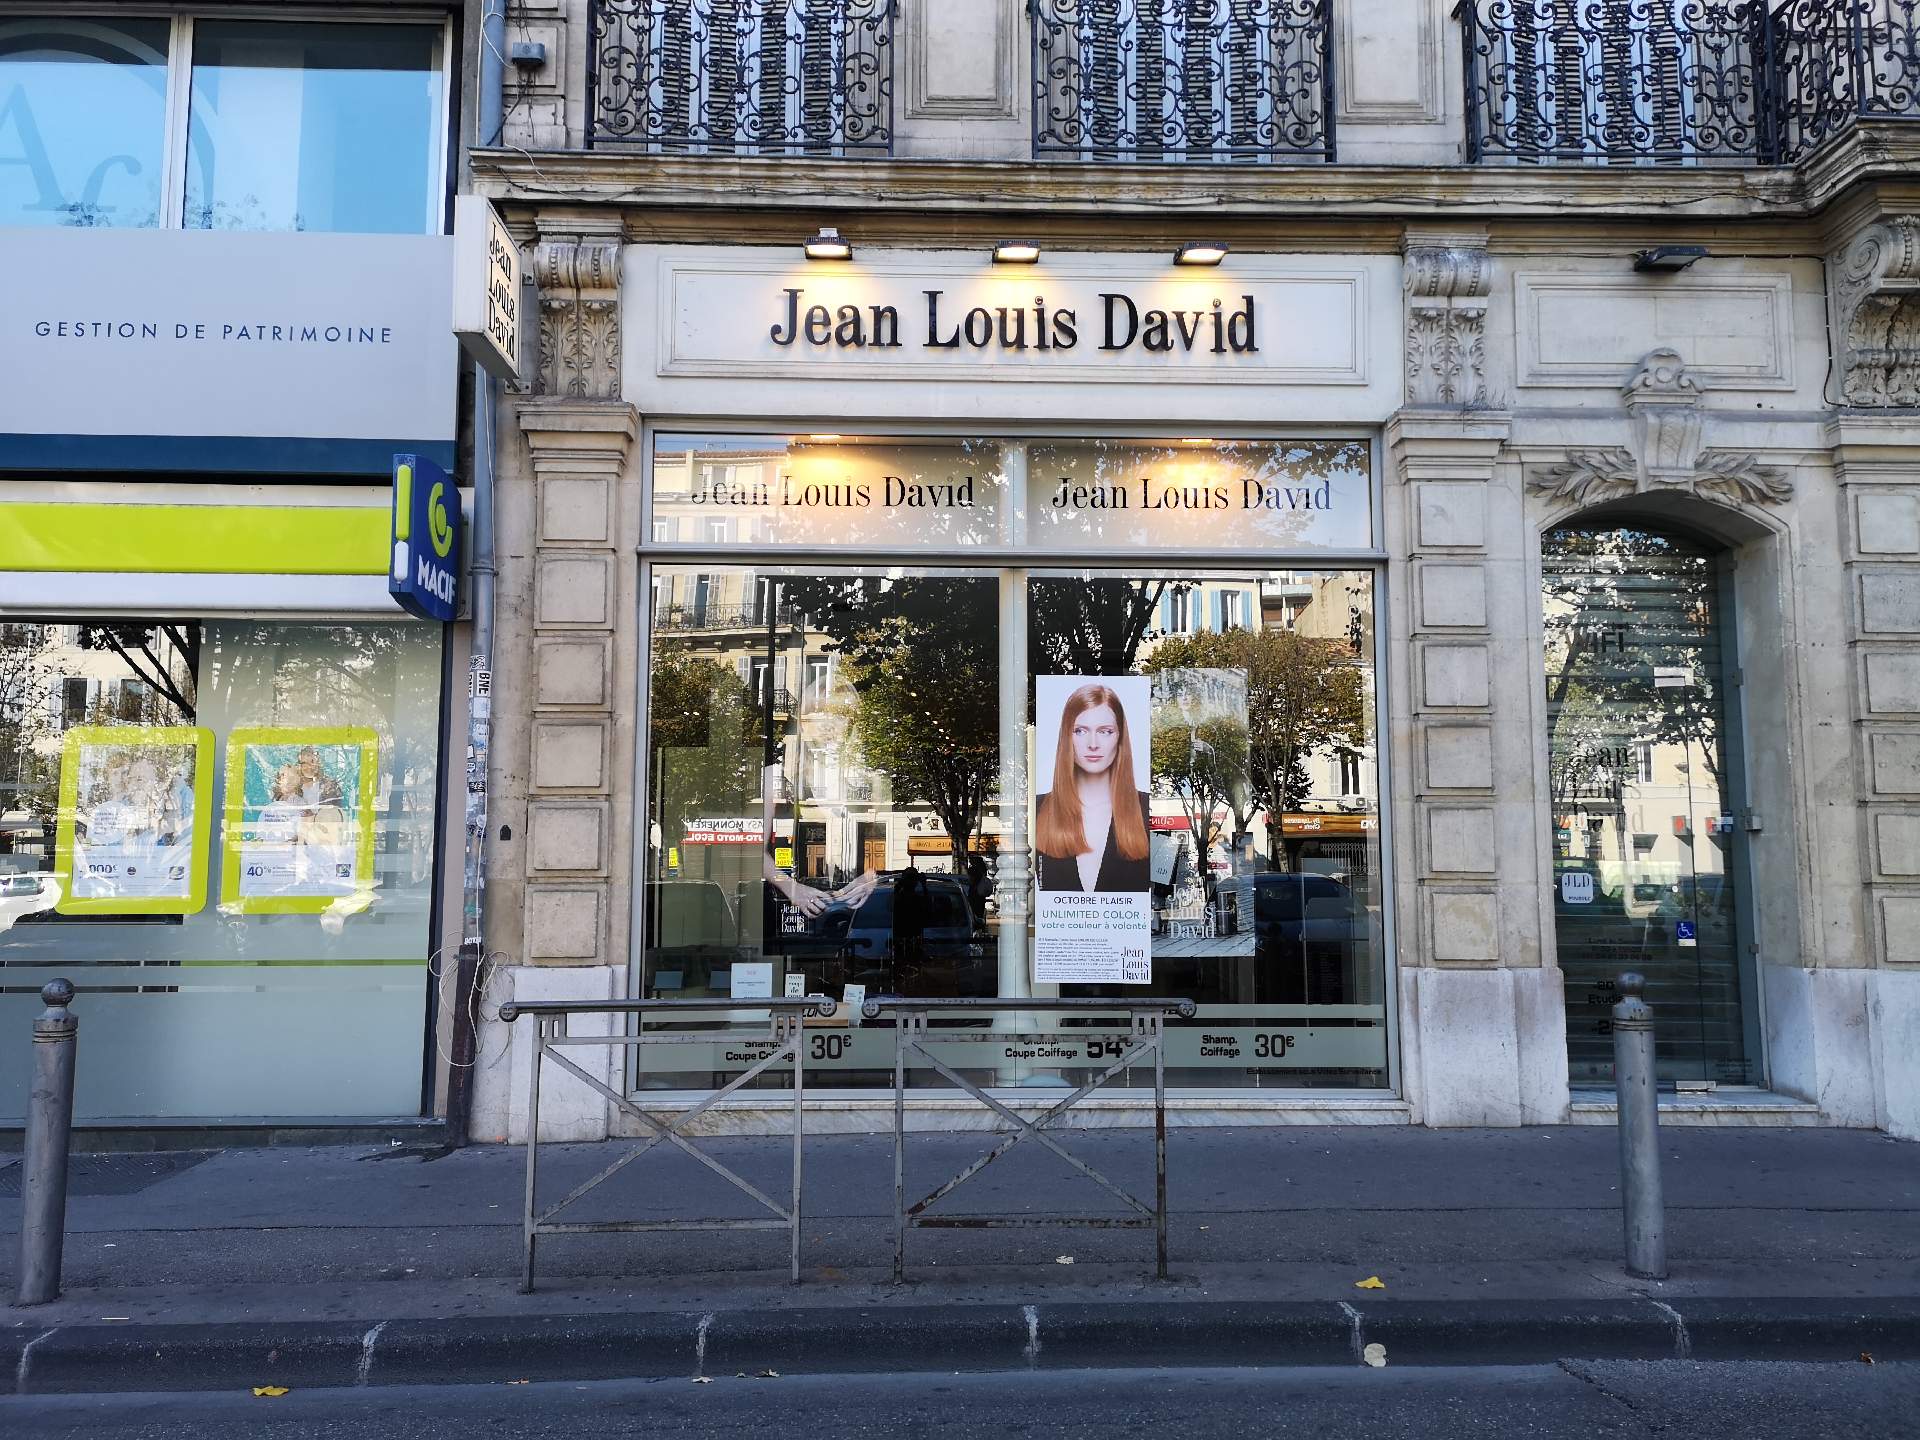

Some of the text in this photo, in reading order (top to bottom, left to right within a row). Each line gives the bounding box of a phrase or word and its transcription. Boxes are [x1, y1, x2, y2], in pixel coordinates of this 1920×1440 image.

[489, 222, 512, 282] Jean
[489, 256, 515, 322] Louis
[770, 288, 1259, 353] Jean Louis David
[35, 321, 391, 343] GESTION DE PATRIMOINE
[488, 295, 515, 361] David
[691, 473, 976, 508] Jean Louis David
[1052, 477, 1333, 510] Jean Louis David
[417, 554, 457, 605] MACIF
[478, 672, 491, 695] BNE
[1564, 874, 1591, 887] JLD
[1053, 896, 1133, 905] OCTOBRE PLAISIR
[780, 903, 800, 914] Jean
[1042, 910, 1100, 919] UNLIMITED
[1103, 910, 1140, 920] COLOR
[781, 913, 805, 923] Louis
[781, 922, 805, 933] David
[1041, 921, 1065, 930] votre
[1067, 920, 1101, 930] couleur
[1112, 921, 1147, 930] volonté
[1168, 920, 1216, 939] David
[1120, 946, 1144, 958] Jean
[1121, 957, 1149, 969] Louis
[1121, 969, 1149, 981] David
[1201, 1034, 1238, 1045] Shamp.
[1254, 1033, 1295, 1058] 30€
[810, 1034, 852, 1060] 30€
[1004, 1047, 1078, 1060] Coupe Coiffage
[1199, 1046, 1241, 1059] Coiffage
[725, 1051, 757, 1062] Coupe
